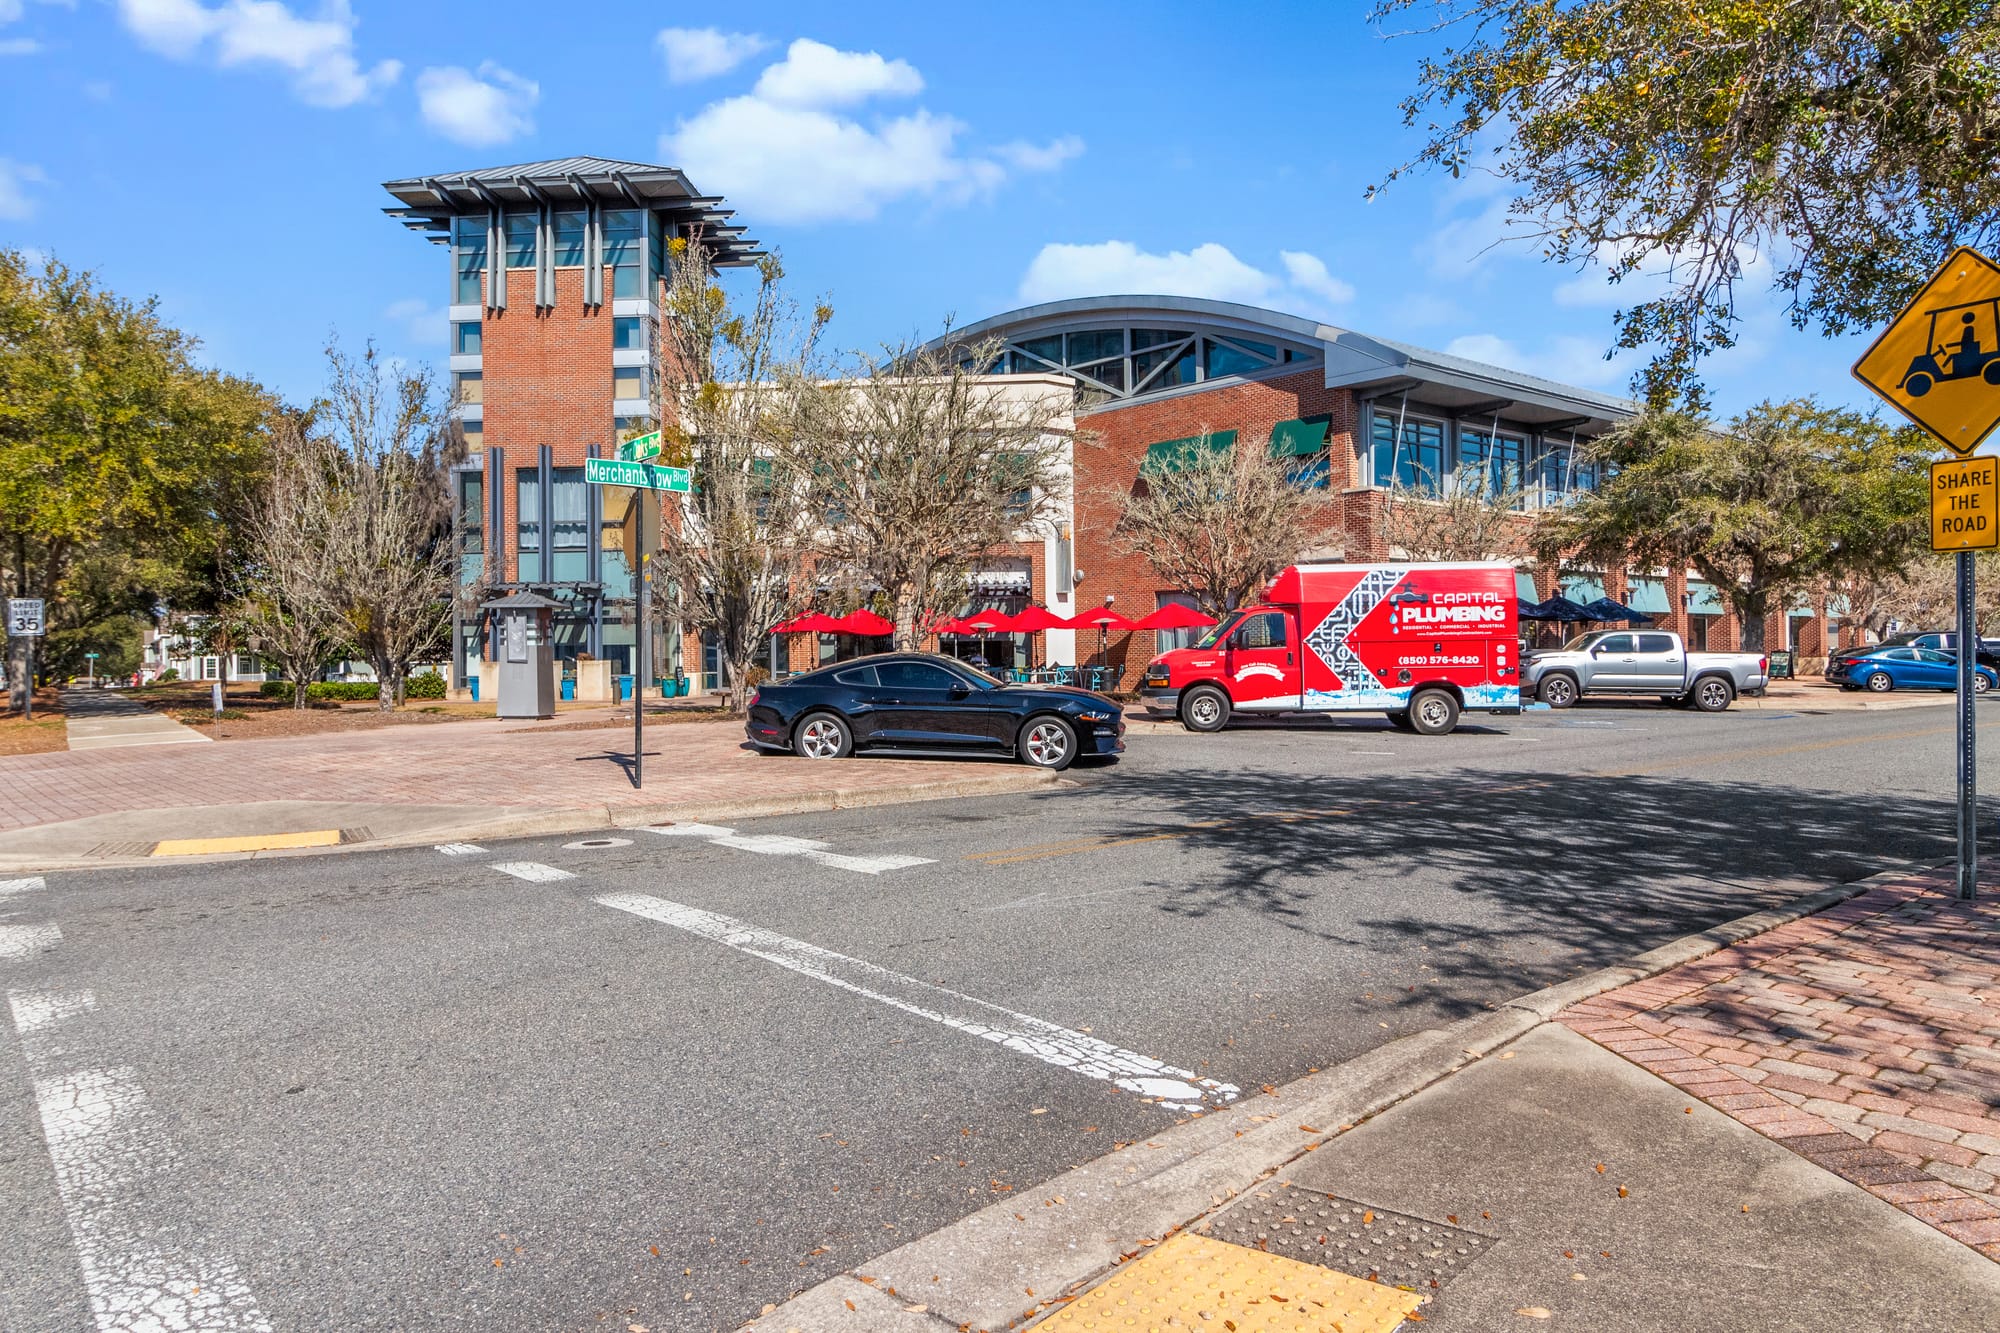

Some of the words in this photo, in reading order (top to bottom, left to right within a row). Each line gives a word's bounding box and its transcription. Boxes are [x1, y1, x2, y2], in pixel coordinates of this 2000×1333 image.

[589, 461, 648, 485] Merchants
[649, 467, 672, 488] Row
[673, 470, 688, 484] Blvd
[1937, 470, 1992, 490] SHARE
[1949, 494, 1980, 511] THE
[1942, 516, 1987, 533] ROAD
[1433, 592, 1505, 604] CAPITAL
[1402, 606, 1505, 623] PLUMBING
[16, 618, 38, 631] 35
[1399, 656, 1427, 665] (850)
[1429, 656, 1480, 665] 576-8420
